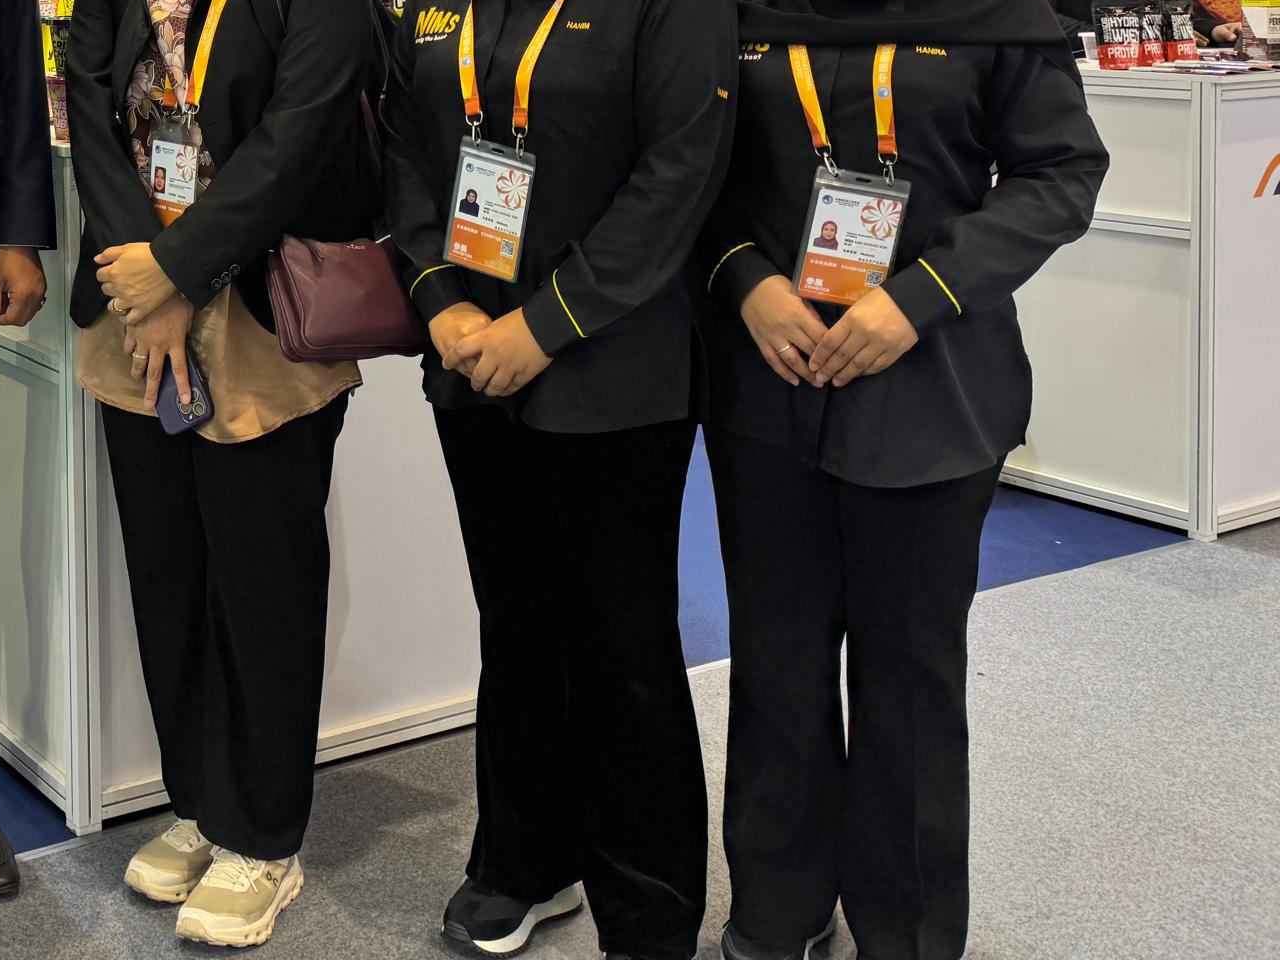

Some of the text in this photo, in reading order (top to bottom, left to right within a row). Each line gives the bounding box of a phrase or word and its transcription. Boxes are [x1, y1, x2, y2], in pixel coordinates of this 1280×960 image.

[415, 6, 461, 38] NIMS
[1111, 28, 1140, 42] WHEY
[744, 53, 763, 62] best
